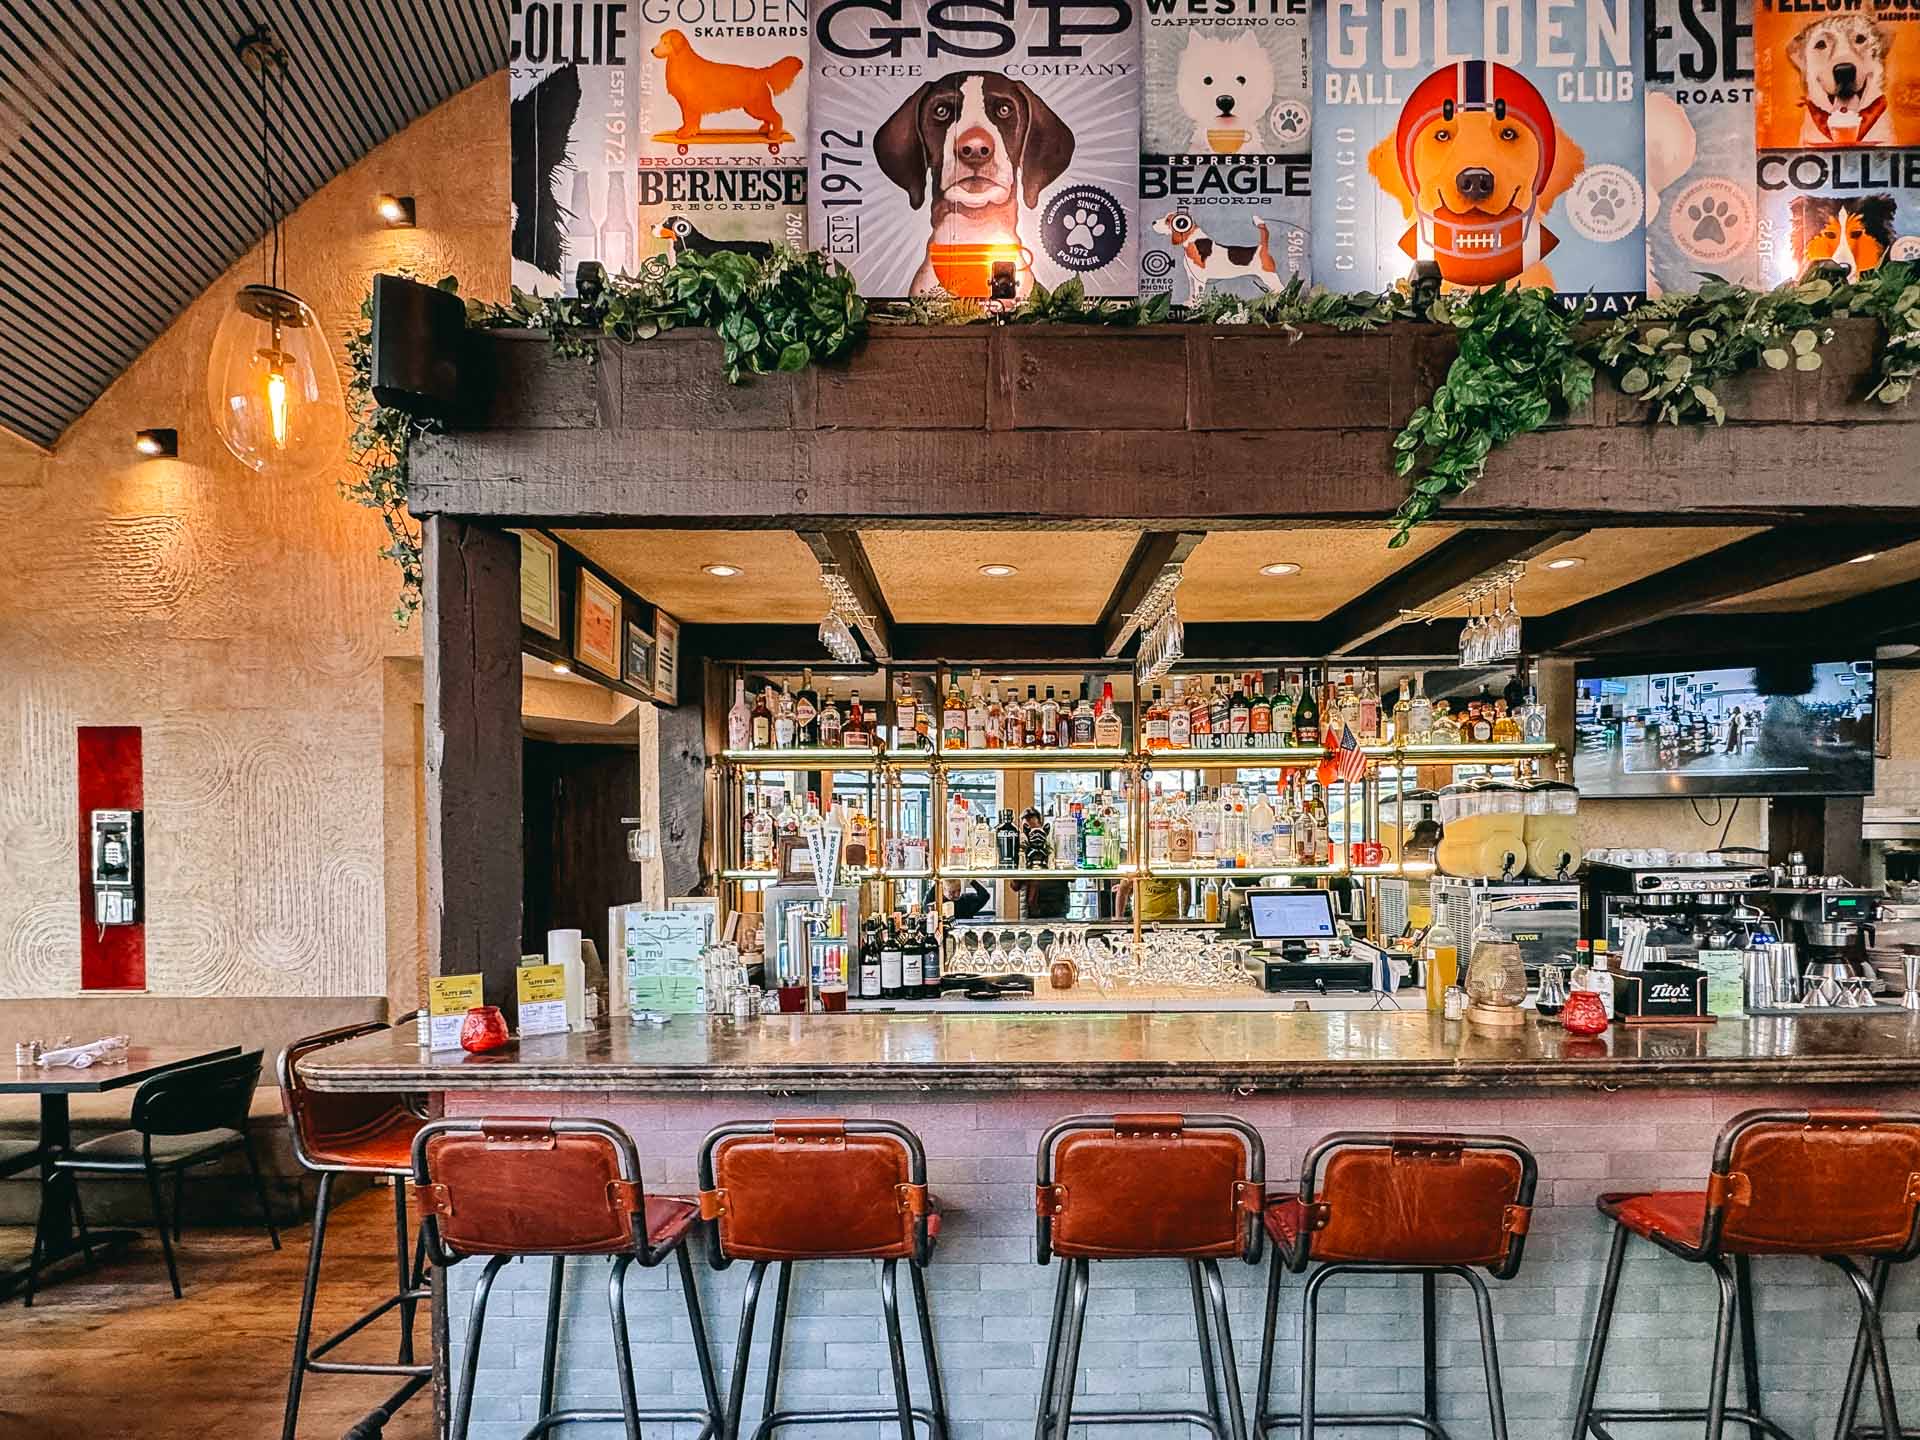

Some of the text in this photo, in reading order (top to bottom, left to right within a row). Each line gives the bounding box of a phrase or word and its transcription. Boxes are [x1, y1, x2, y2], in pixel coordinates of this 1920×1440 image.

[642, 0, 808, 24] GOLDEN
[1151, 18, 1268, 26] CAPPUCCINO
[694, 26, 808, 38] SKATEBOARDS
[815, 0, 1132, 58] GSP
[1325, 0, 1632, 69] GOLDEN
[821, 63, 1131, 77] COFFEE COMPANY
[1326, 74, 1402, 104] BALL
[1557, 71, 1634, 102] CLUB
[1677, 89, 1753, 105] ROAST
[605, 112, 626, 166] 1972
[640, 157, 807, 167] BROOKLYN, NY
[820, 129, 863, 208] 1972
[1169, 156, 1276, 165] ESPRESSO
[1757, 154, 1920, 190] COLLIE
[639, 169, 808, 205] BERNESE
[1139, 165, 1311, 199] BEAGLE
[671, 203, 776, 211] RECORDS
[1077, 199, 1102, 211] SINCE
[1177, 197, 1272, 205] RECORDS
[1335, 127, 1356, 271] CHICAGO
[785, 212, 803, 240] 1962
[1047, 191, 1121, 236] GERMAN SHORTHAIRED
[1069, 246, 1089, 257] 1972
[1287, 230, 1304, 258] 1965
[1758, 219, 1773, 257] 1972
[1057, 250, 1100, 266] POINTER
[1191, 732, 1286, 749] LIVE LOVE BARK
